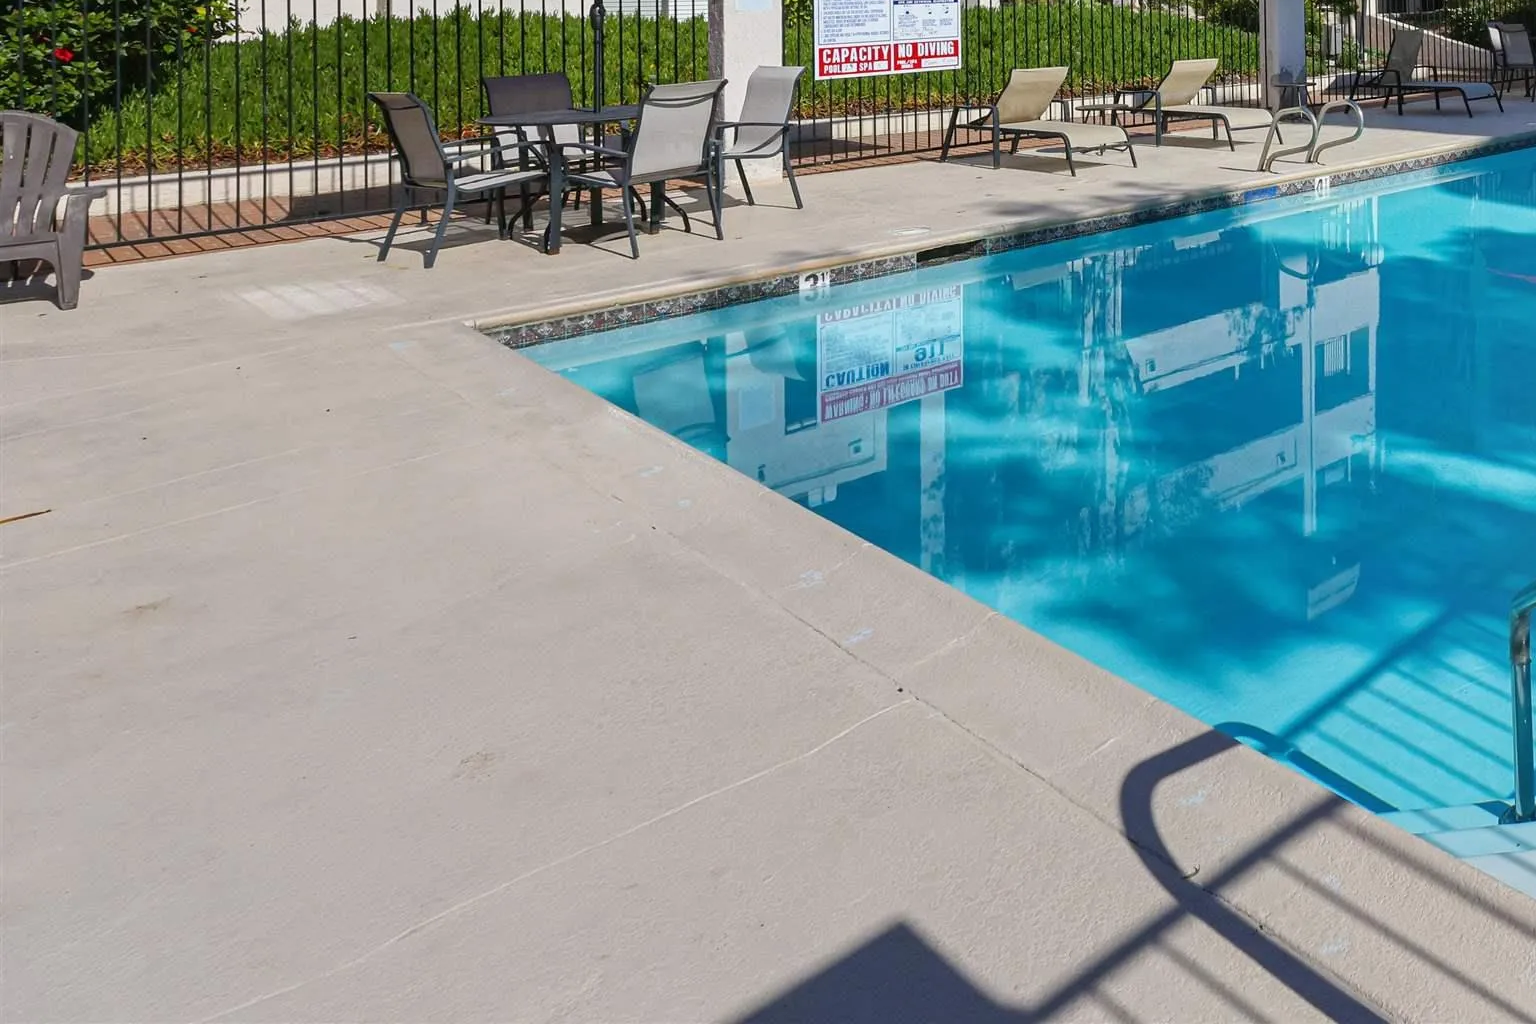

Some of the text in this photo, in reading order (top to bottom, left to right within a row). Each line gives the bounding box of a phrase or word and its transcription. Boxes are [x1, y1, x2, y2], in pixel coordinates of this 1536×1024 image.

[823, 45, 889, 63] CAPACITY
[897, 41, 955, 58] NO DIVING
[824, 64, 842, 74] POOL
[859, 62, 873, 72] SPA
